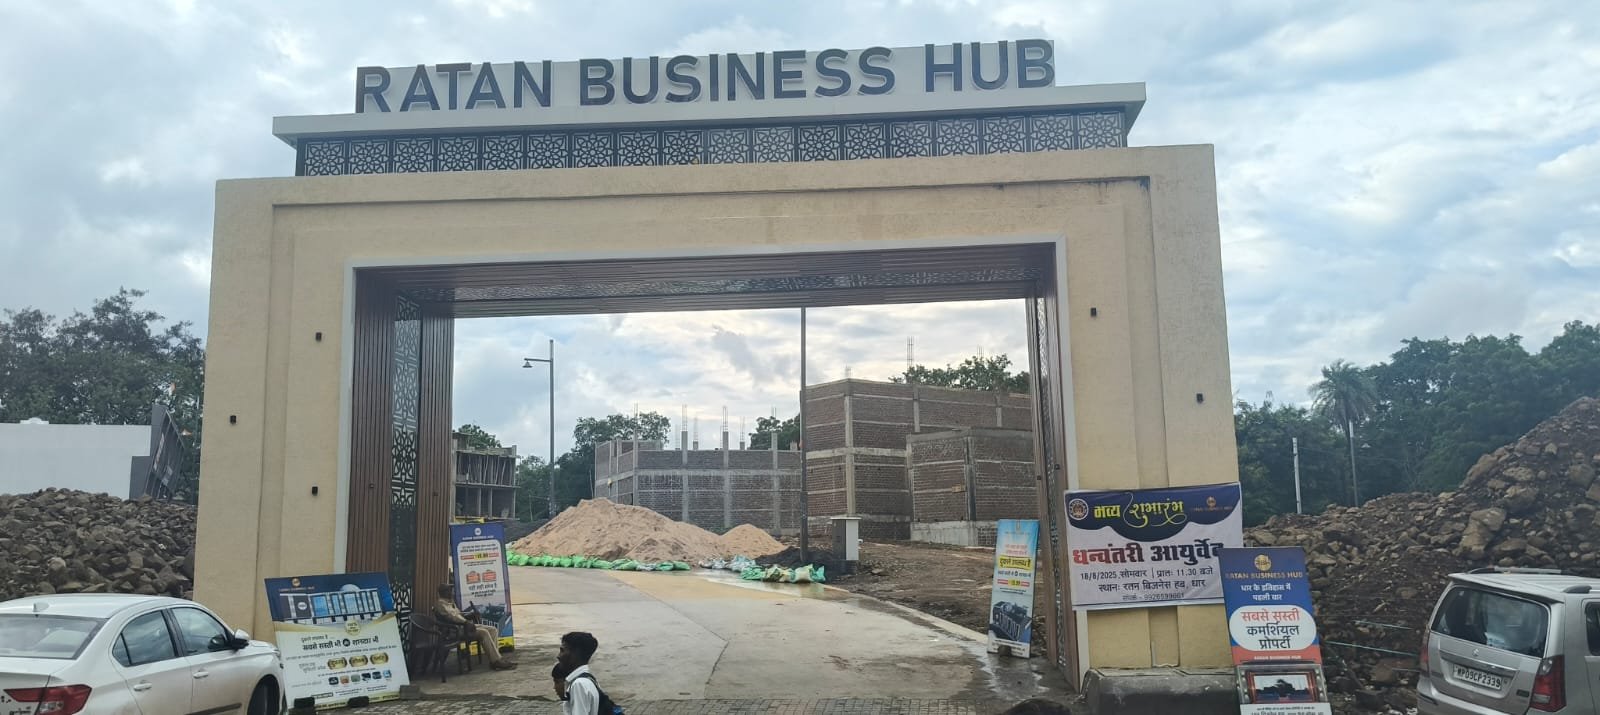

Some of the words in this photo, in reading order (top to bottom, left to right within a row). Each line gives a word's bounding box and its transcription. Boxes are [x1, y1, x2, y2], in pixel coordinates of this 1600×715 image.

[356, 59, 551, 113] RATAN
[579, 46, 896, 106] BUSINESS
[925, 39, 1055, 93] HUB
[1094, 504, 1121, 518] भव्य
[1125, 497, 1186, 527] शुभारंभ
[1073, 542, 1145, 565] धन्वंतरी
[1123, 581, 1140, 591] रतन
[1191, 579, 1206, 588] धार
[1241, 609, 1269, 621] सबसे
[1272, 608, 1300, 621] सस्ती
[1247, 621, 1300, 636] कमर्शियल
[1259, 636, 1291, 649] प्रोपर्टी
